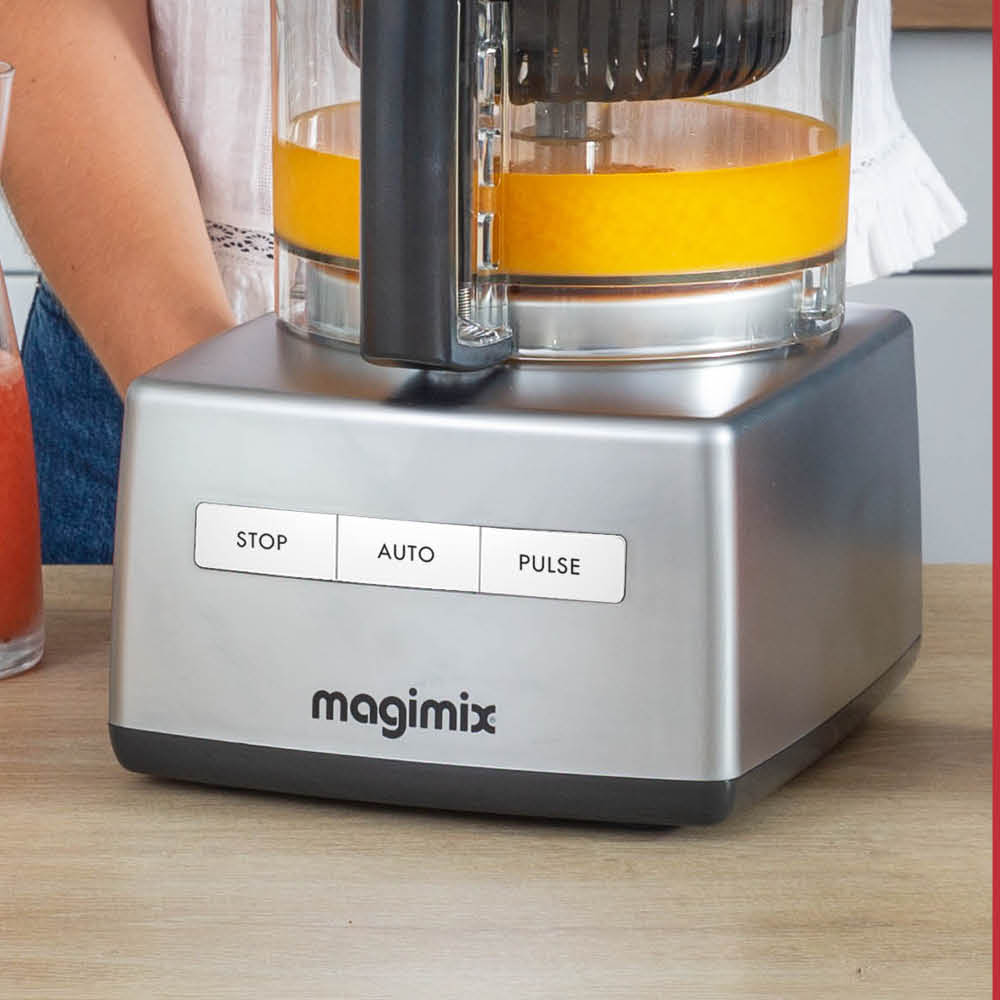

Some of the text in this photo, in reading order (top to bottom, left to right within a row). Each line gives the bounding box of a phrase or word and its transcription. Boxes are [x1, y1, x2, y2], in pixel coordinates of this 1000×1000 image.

[236, 530, 580, 576] STOP AUTO PULSE
[312, 687, 496, 739] magimix
